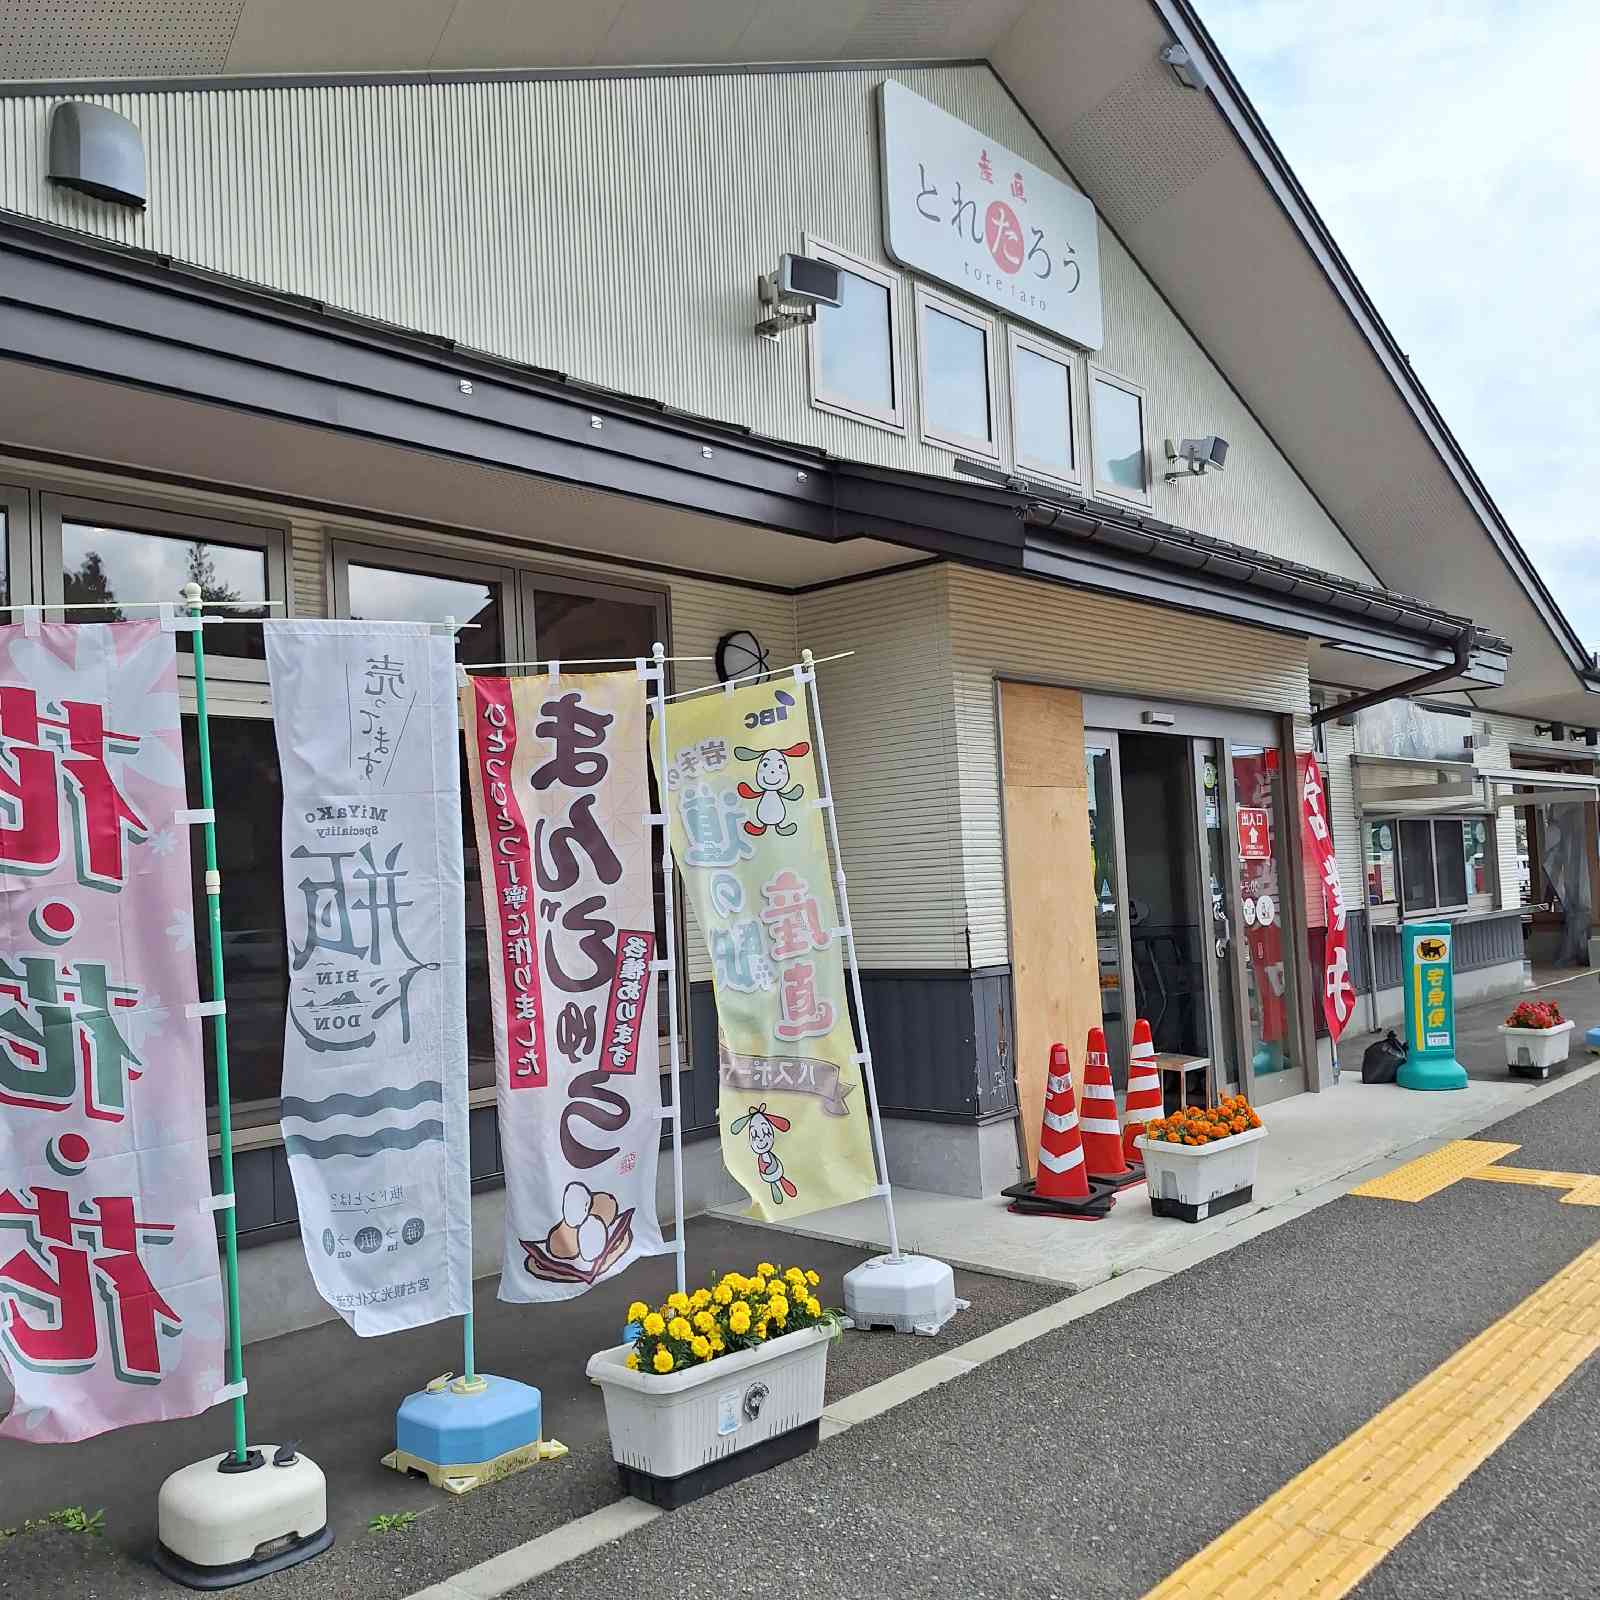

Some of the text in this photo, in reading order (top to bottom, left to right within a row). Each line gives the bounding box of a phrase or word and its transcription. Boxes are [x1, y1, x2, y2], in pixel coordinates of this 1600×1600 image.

[977, 148, 1028, 203] 産直
[915, 162, 1081, 294] とれたろう
[1240, 813, 1263, 827] 出入口
